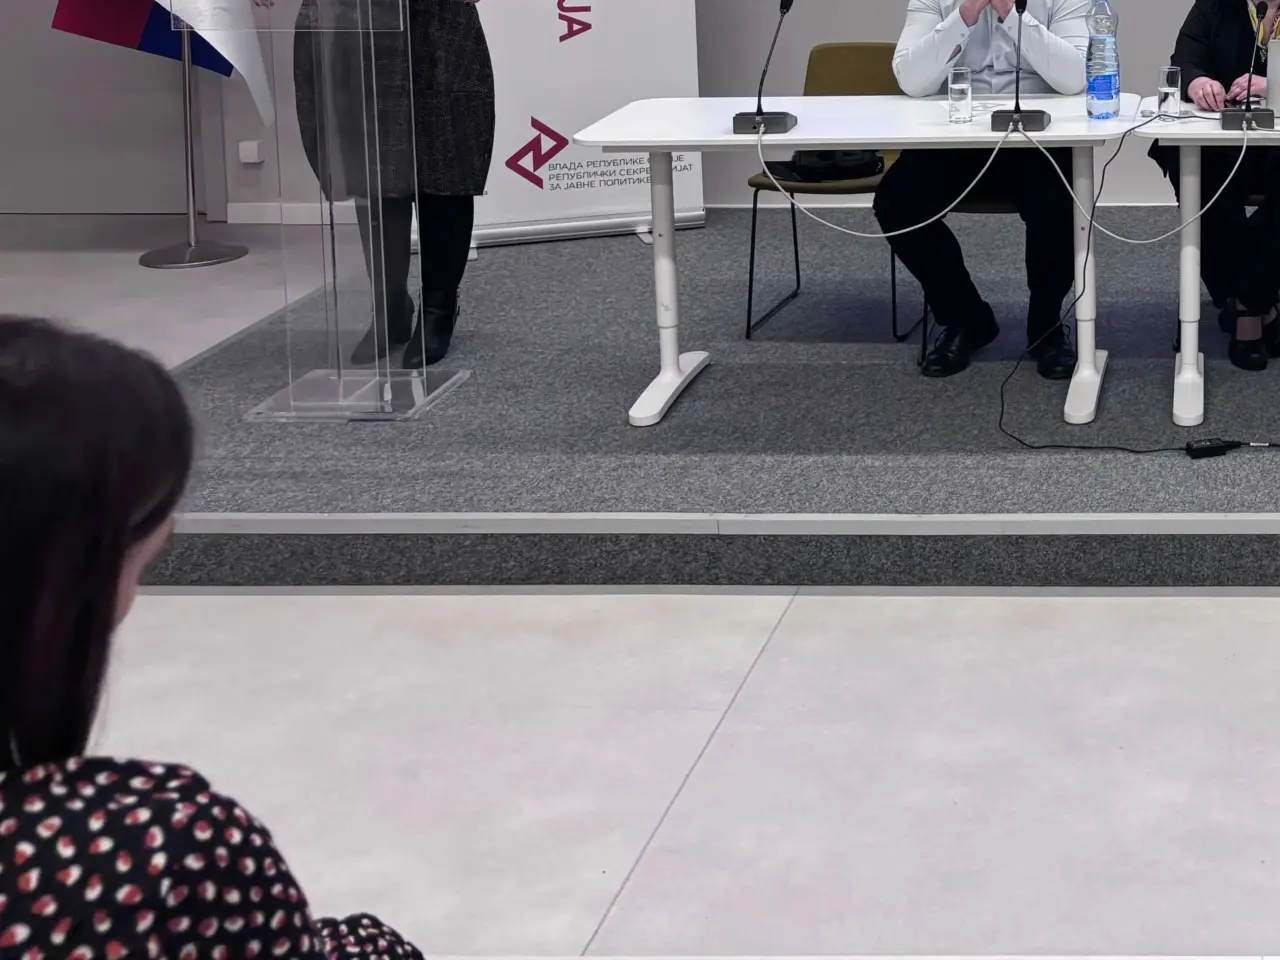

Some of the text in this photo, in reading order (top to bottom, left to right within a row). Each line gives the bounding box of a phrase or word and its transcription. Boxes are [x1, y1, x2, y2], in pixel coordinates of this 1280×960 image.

[548, 162, 584, 172] ВЛАДА
[586, 157, 645, 168] РЕПУБЛИКЕ
[548, 170, 616, 182] РЕПУБЛИЧКИ
[549, 177, 652, 191] ЗА ЈАВНЕ ПОЛИТИКЕ
